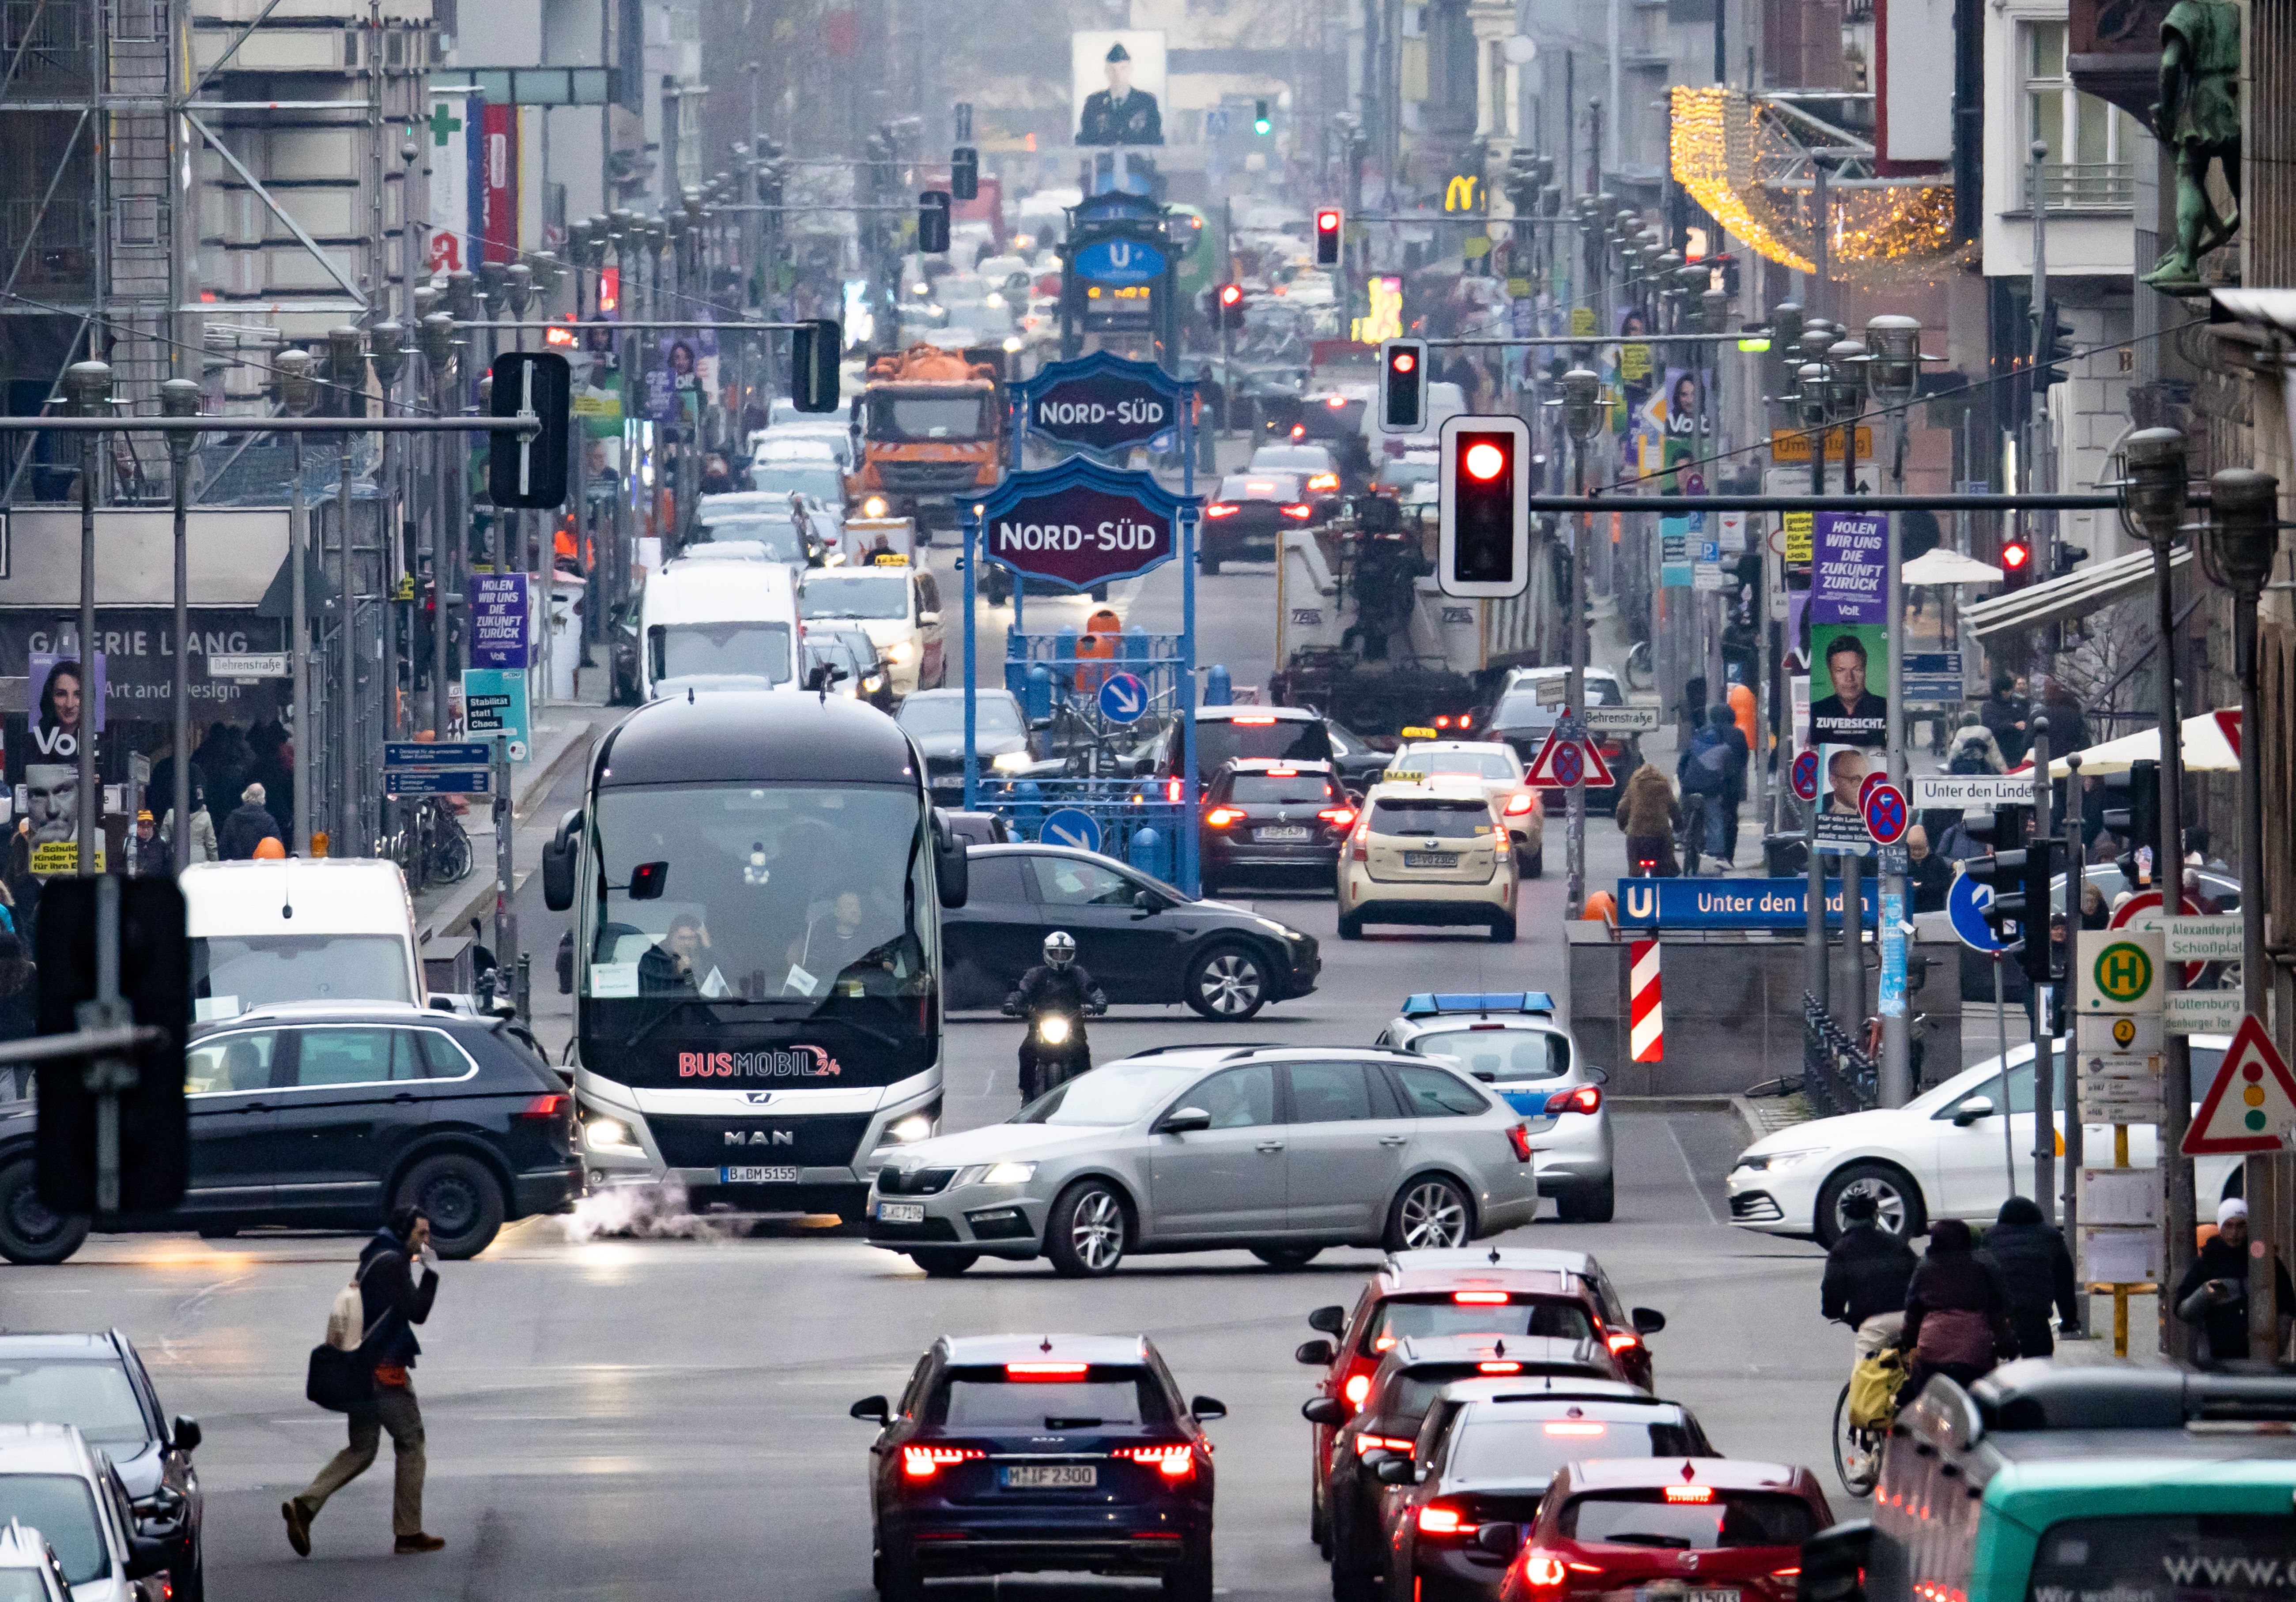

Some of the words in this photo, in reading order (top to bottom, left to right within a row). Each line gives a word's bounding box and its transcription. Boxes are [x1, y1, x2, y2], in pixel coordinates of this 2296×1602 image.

[1109, 244, 1129, 267] U
[1040, 398, 1164, 424] NORD-SÜD
[1000, 519, 1156, 550] NORD-SÜD
[1832, 521, 1877, 535] HOLEN
[1826, 534, 1852, 547] WIR
[1854, 535, 1882, 549] UNS
[1841, 549, 1864, 562] DIE
[1820, 562, 1884, 577] ZUKUNFT
[482, 580, 514, 591] HOLEN
[1823, 574, 1879, 591] ZURÜCK
[478, 592, 496, 603] WIR
[497, 592, 519, 603] UNS
[489, 604, 506, 614] DIE
[1838, 604, 1860, 616] Volt
[476, 615, 523, 627] ZUKUNFT
[479, 626, 520, 638] ZURÜCK
[161, 631, 248, 656] LANG
[215, 659, 281, 672] Behrenstraße
[105, 681, 130, 698] Art
[135, 680, 170, 698] and
[187, 681, 240, 702] esign
[470, 697, 508, 706] Stabilität
[1586, 712, 1653, 726] Behrenstraße
[1816, 717, 1886, 728] ZUVERSICHT.
[1926, 783, 1963, 797] Unter
[1967, 783, 1991, 797] den
[1996, 783, 2033, 797] Linde
[1627, 886, 1653, 918] U
[1698, 892, 1754, 912] Unter
[1760, 891, 1796, 912] den
[2172, 923, 2243, 936] Alexanderpla
[2172, 941, 2243, 956] Schloßplat
[2110, 956, 2137, 989] H
[725, 1131, 793, 1145] MAN
[730, 1168, 737, 1180] B
[764, 1168, 795, 1180] 5155
[1052, 1467, 1092, 1482] 2300
